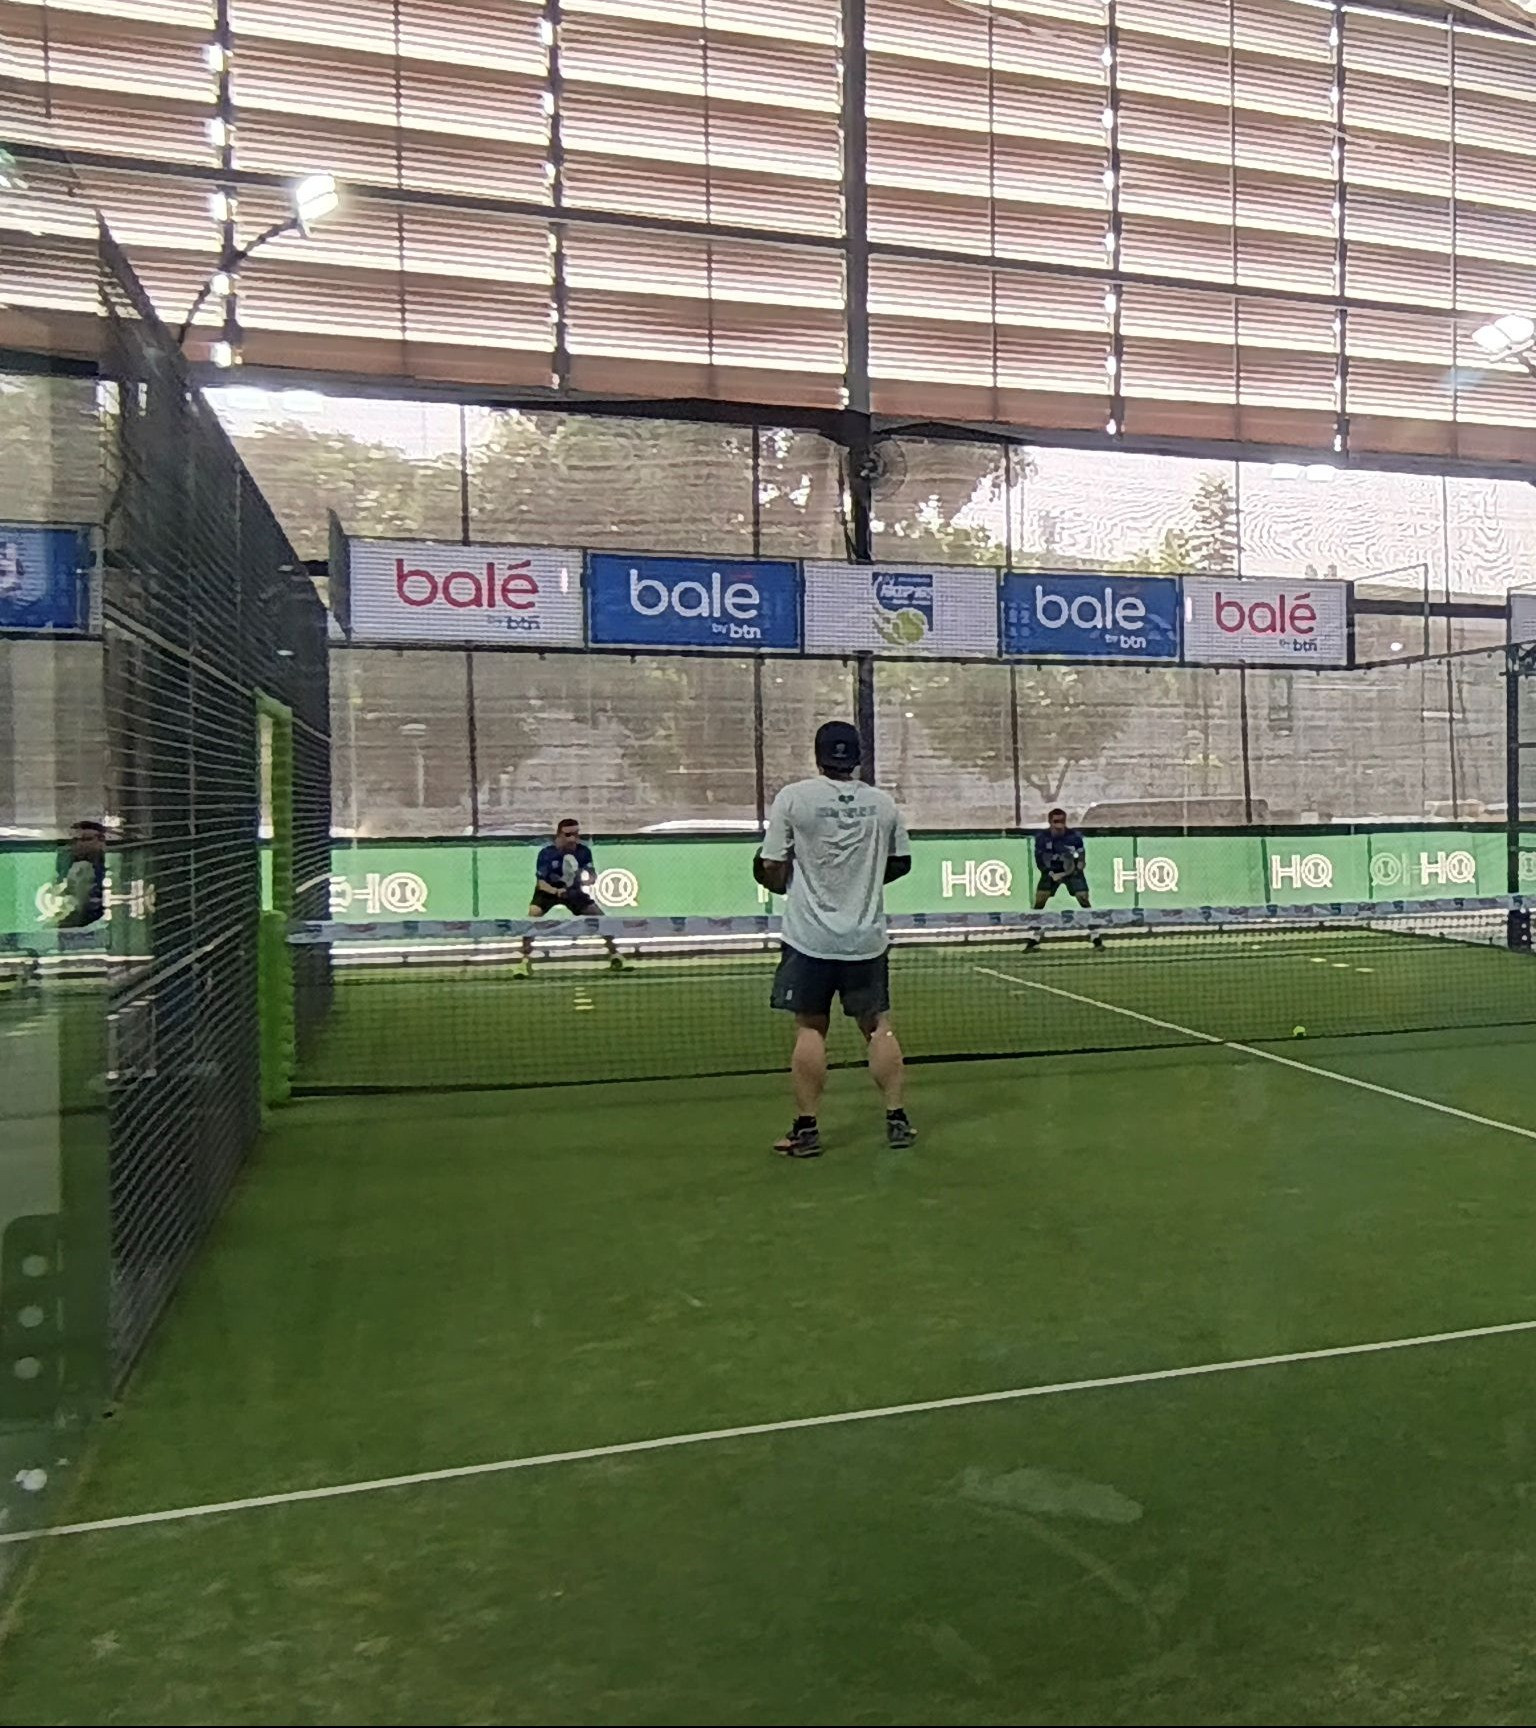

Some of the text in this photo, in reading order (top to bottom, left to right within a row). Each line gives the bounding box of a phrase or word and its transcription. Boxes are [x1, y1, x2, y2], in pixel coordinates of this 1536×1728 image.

[395, 558, 539, 610] balé
[506, 615, 541, 630] btn
[1215, 592, 1317, 634] balé
[729, 624, 762, 639] btn
[1120, 635, 1147, 648] btn
[941, 860, 1011, 897] HQ
[1113, 857, 1179, 893] HQ
[1272, 853, 1333, 889] HQ
[1421, 851, 1476, 885] HQ
